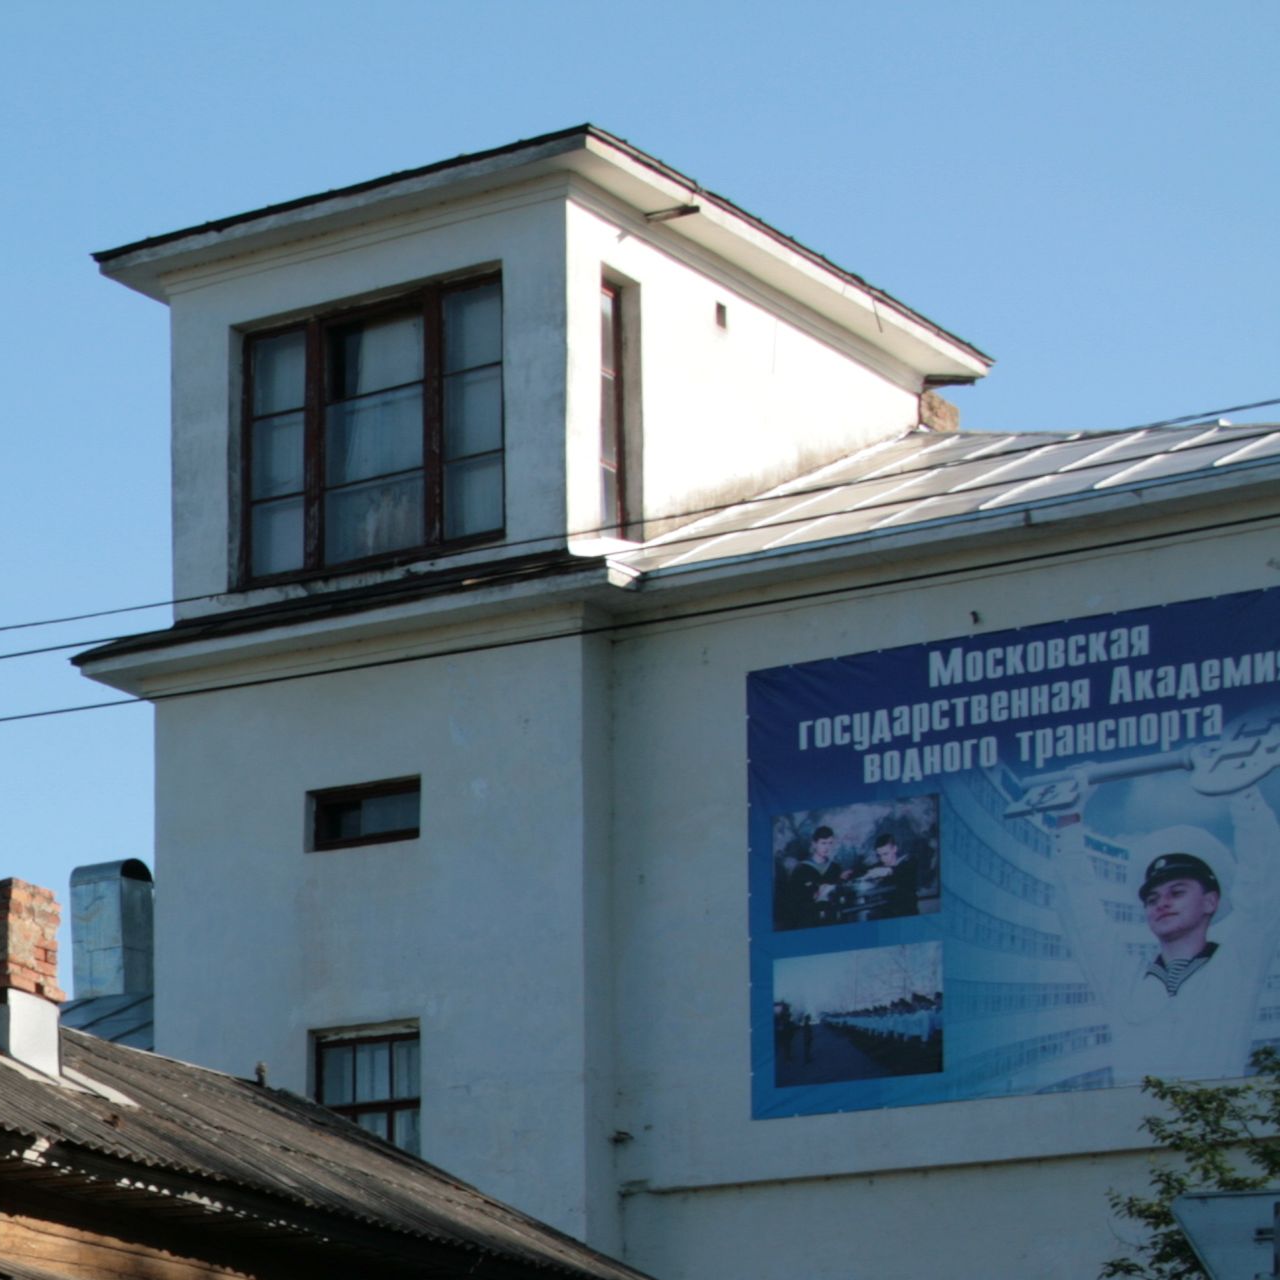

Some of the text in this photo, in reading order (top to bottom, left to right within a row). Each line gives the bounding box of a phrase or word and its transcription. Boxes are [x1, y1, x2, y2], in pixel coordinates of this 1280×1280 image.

[928, 623, 1150, 689] Московская
[799, 677, 1090, 751] государственная
[863, 703, 1223, 785] водного транспорта
